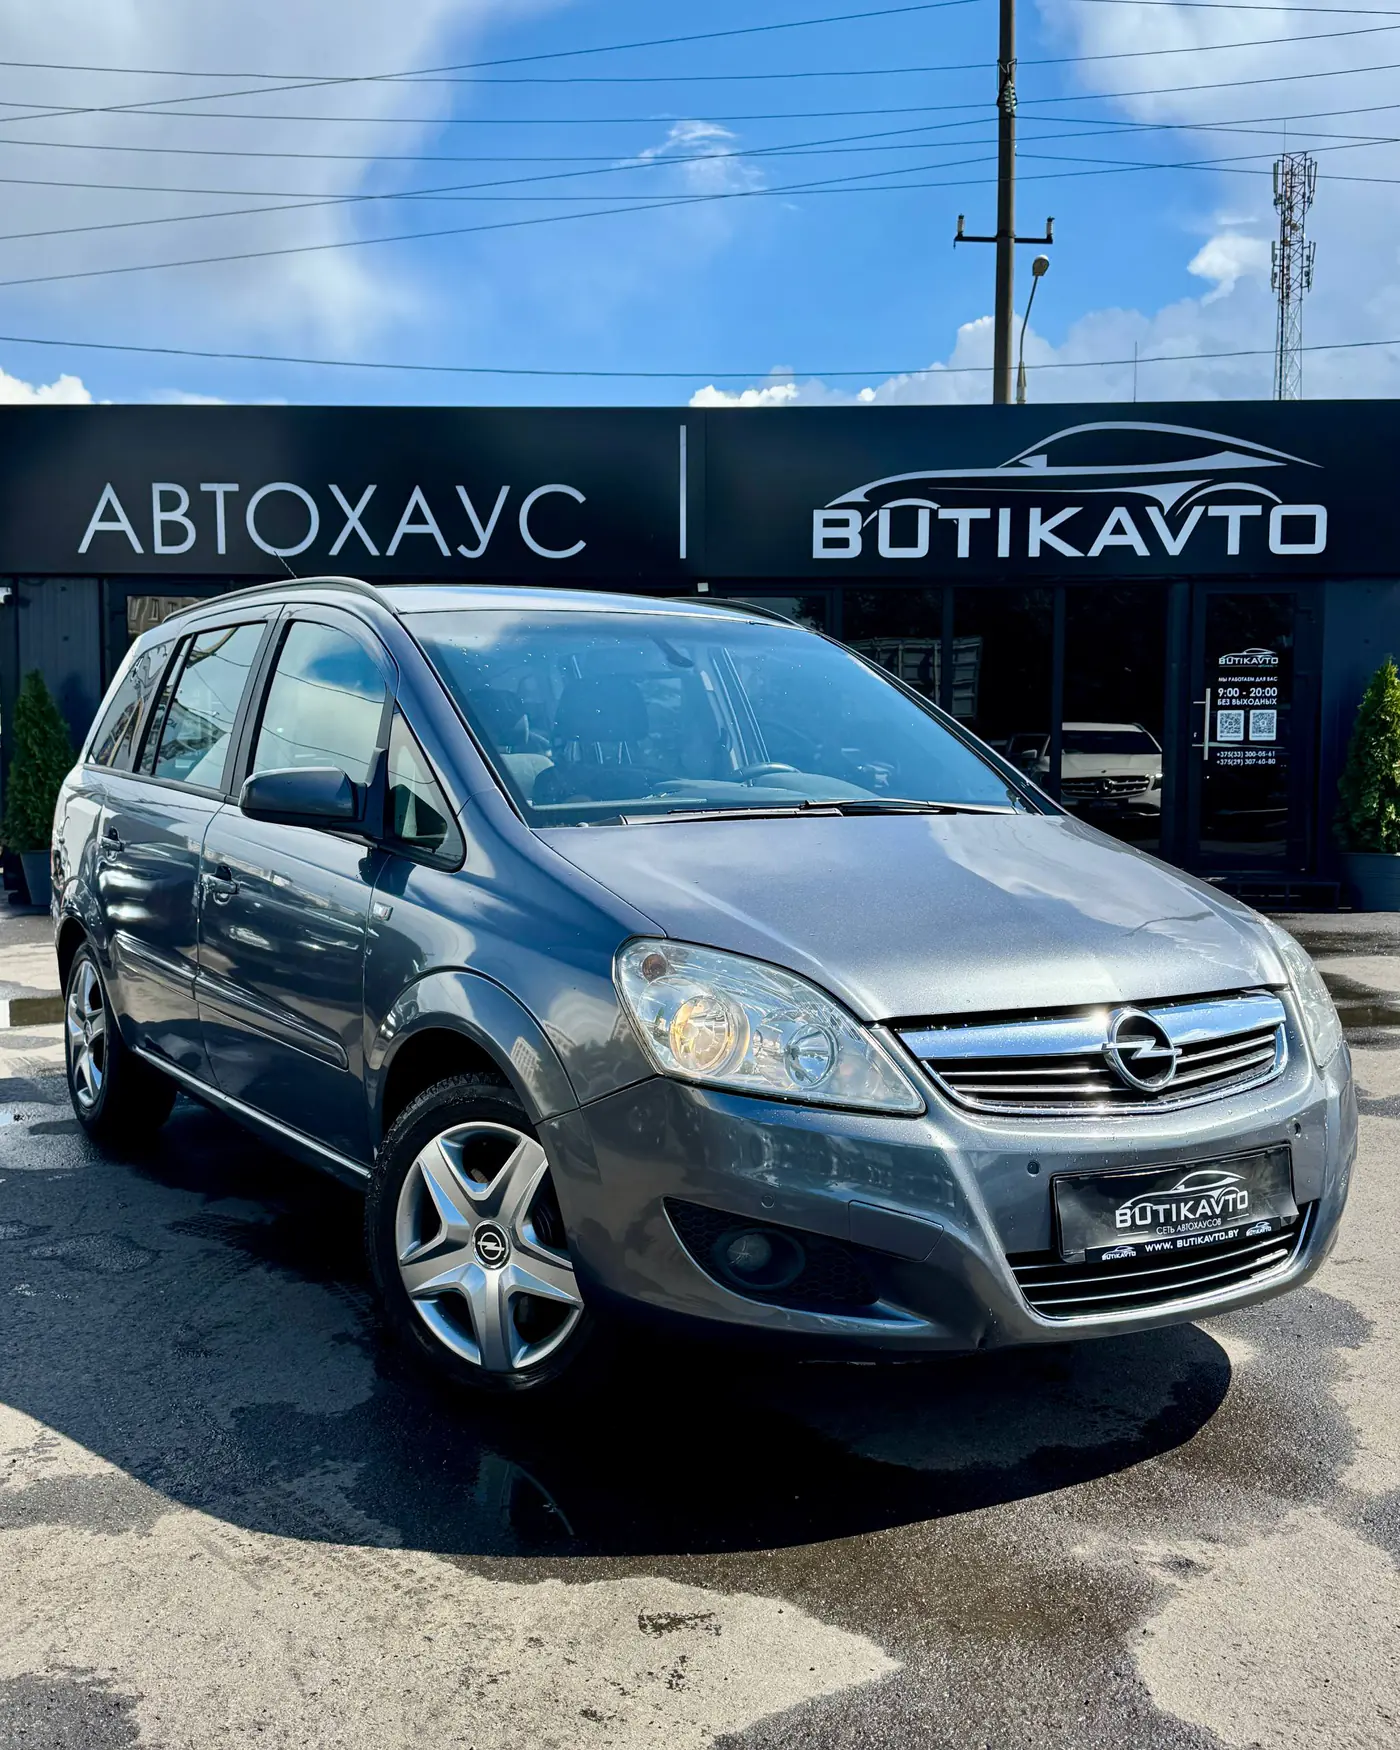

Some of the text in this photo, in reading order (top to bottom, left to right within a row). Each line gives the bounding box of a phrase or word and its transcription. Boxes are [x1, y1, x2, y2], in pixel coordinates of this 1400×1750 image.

[78, 481, 588, 560] АВТОХАУС
[812, 503, 1327, 559] BUTIKAVTO
[1218, 657, 1279, 665] BUTIKAVTO
[1218, 687, 1240, 697] 9:00
[1249, 687, 1278, 697] 20:00
[1217, 698, 1277, 706] БЕЗ ВЫХОДНЫХ
[1216, 758, 1243, 766] +375(29)
[1115, 1190, 1249, 1229] BUTIKAVTO
[1156, 1217, 1222, 1235] СЕТЬ АВТОХАУСОВ
[1144, 1229, 1240, 1253] WWW. BUTIKAVTO.BY
[1101, 1250, 1137, 1261] BUTIKAVTO
